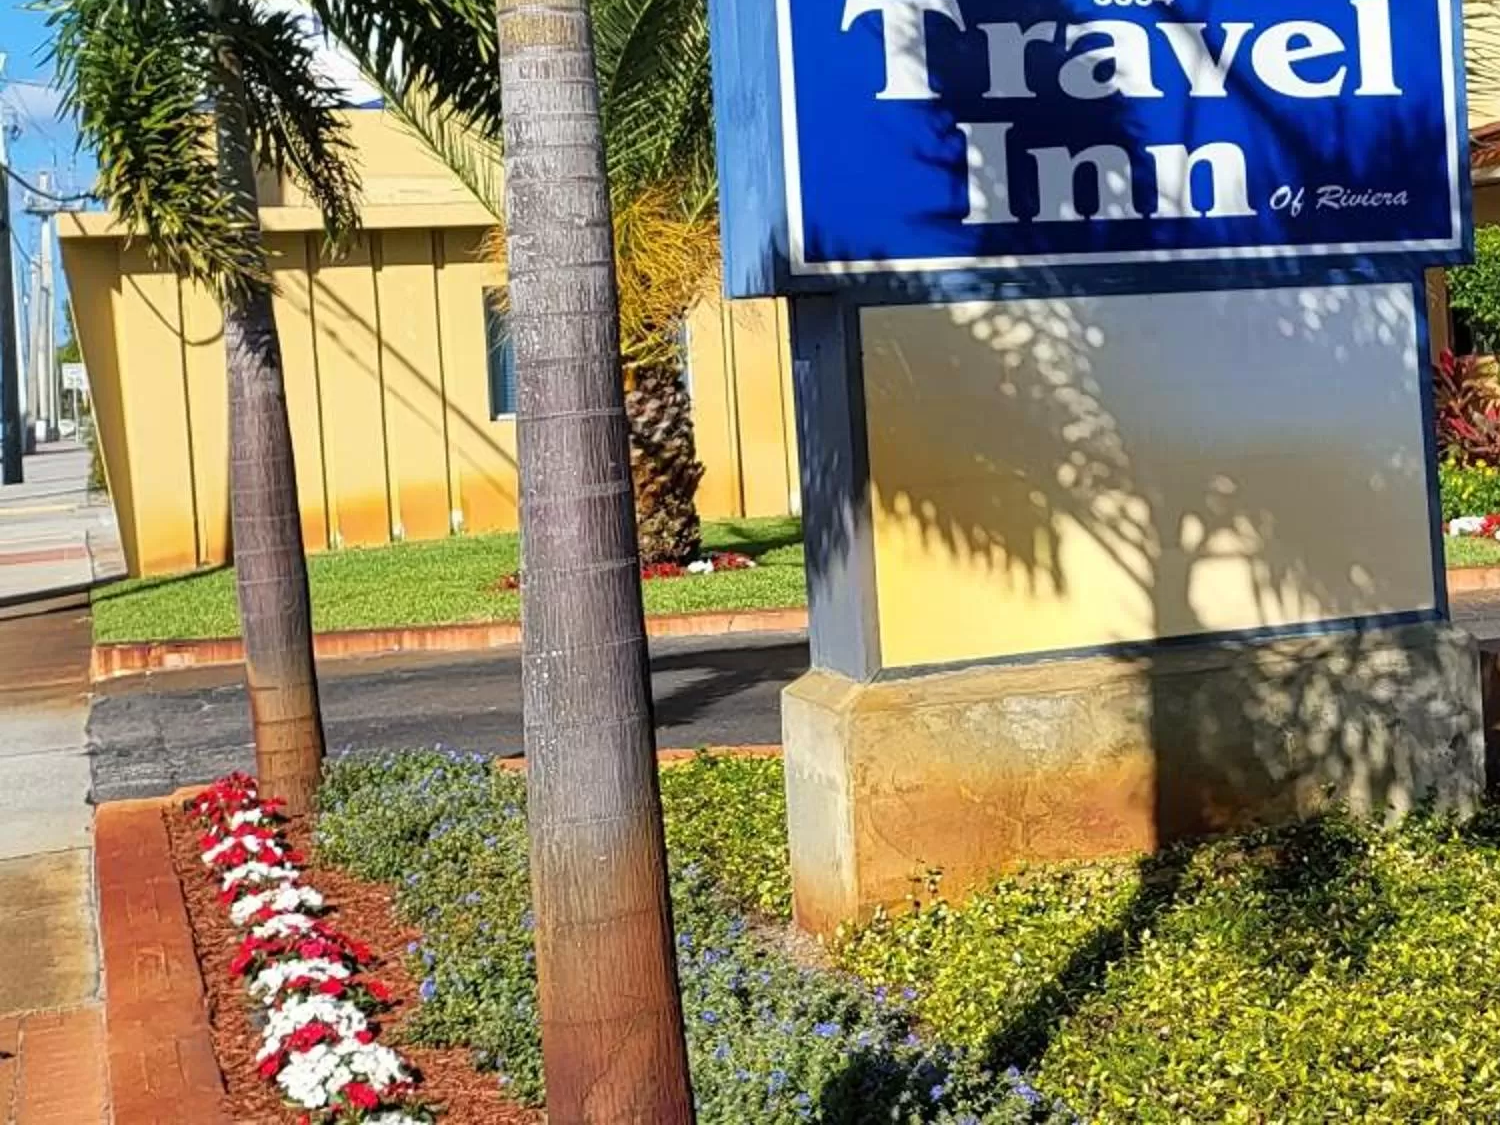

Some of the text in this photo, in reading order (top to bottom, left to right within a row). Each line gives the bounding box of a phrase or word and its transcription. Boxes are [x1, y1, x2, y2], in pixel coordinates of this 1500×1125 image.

[956, 121, 1408, 225] Inn Of Riviera
